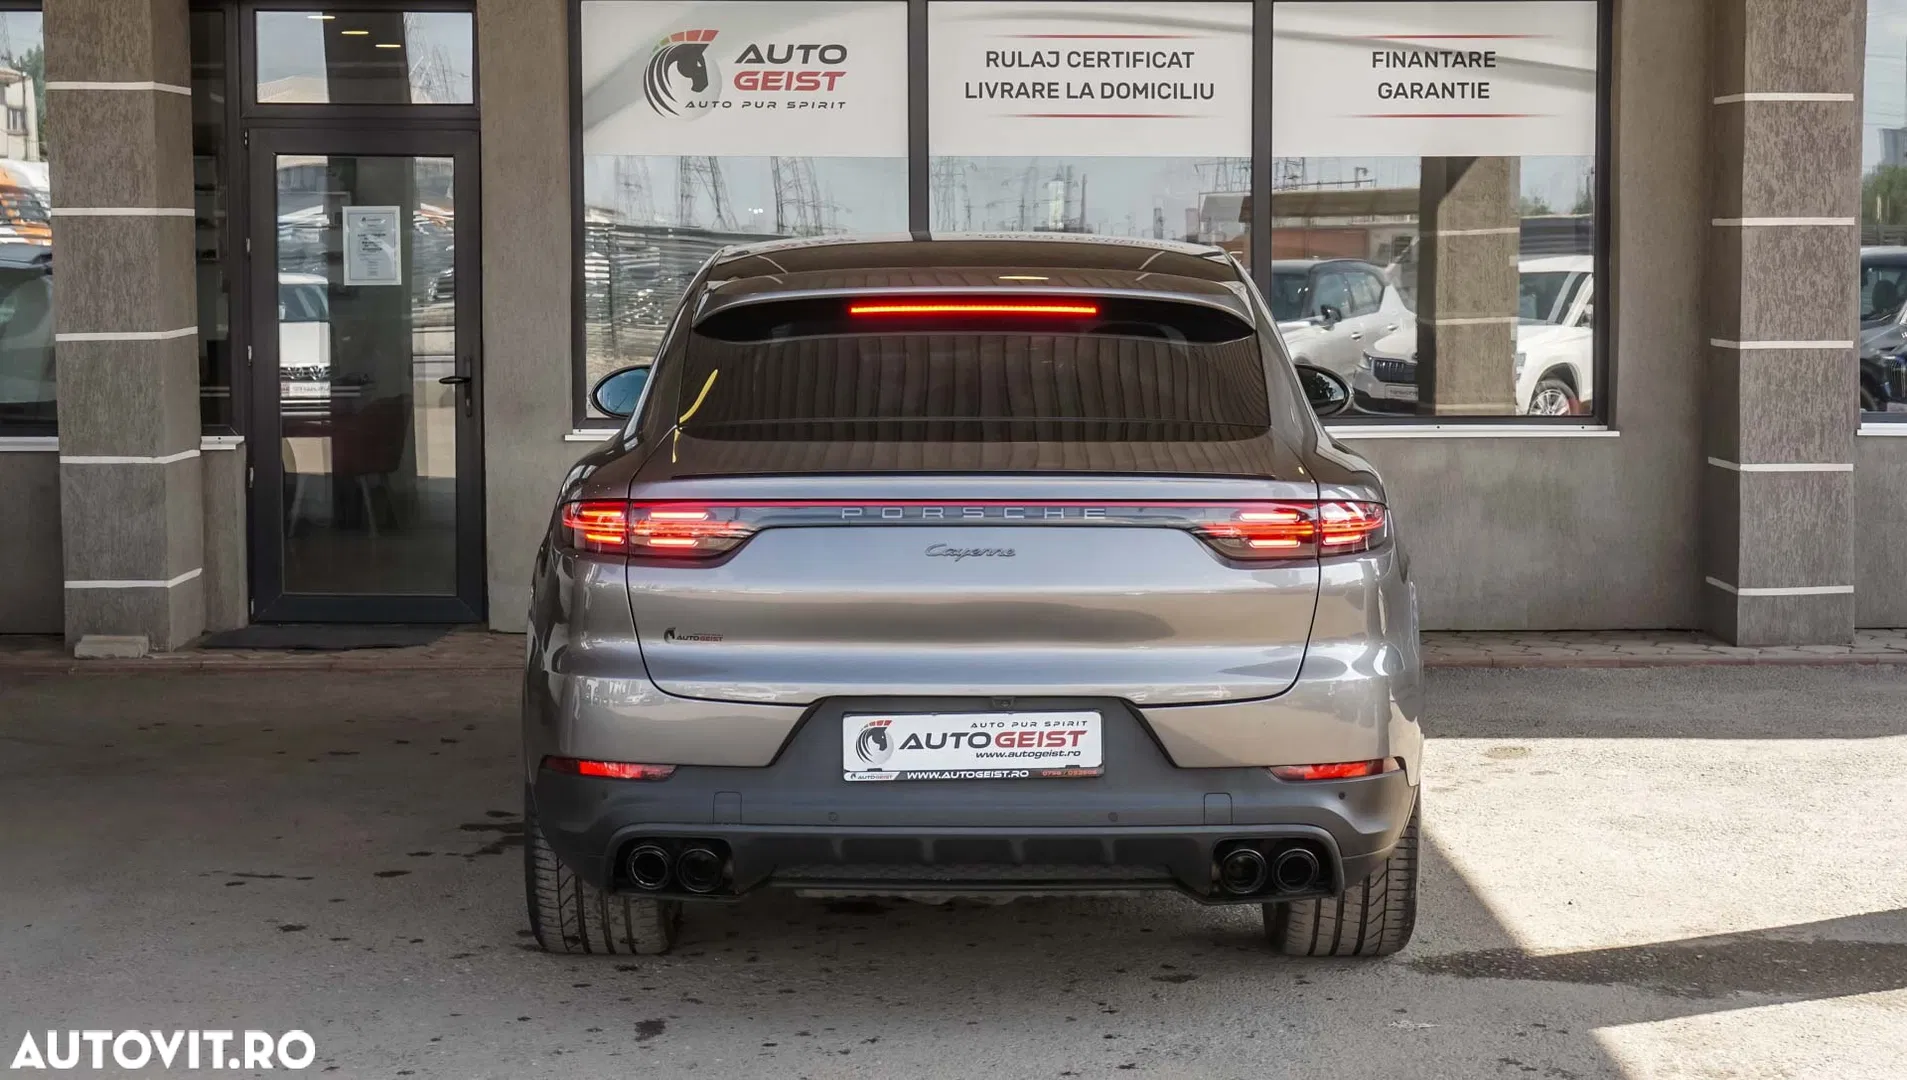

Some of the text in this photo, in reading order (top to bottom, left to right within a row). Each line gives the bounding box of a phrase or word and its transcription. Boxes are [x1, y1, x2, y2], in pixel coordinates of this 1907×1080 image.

[734, 43, 848, 65] AUTO
[985, 50, 1195, 69] RULAJ CERTIFICAT
[1372, 51, 1497, 69] FINANTARE
[733, 70, 848, 92] GEIST
[1377, 81, 1491, 99] GARANTIE
[965, 81, 1215, 100] LIVRARE LA DOMICILIU
[684, 100, 847, 109] AUTO PUR SPIRIT
[841, 506, 1107, 520] PORSCHE
[924, 543, 1016, 562] Cayenne
[976, 749, 1082, 760] www.autogeist.ro
[906, 769, 1030, 779] WWW.AUTOGEIST.RO
